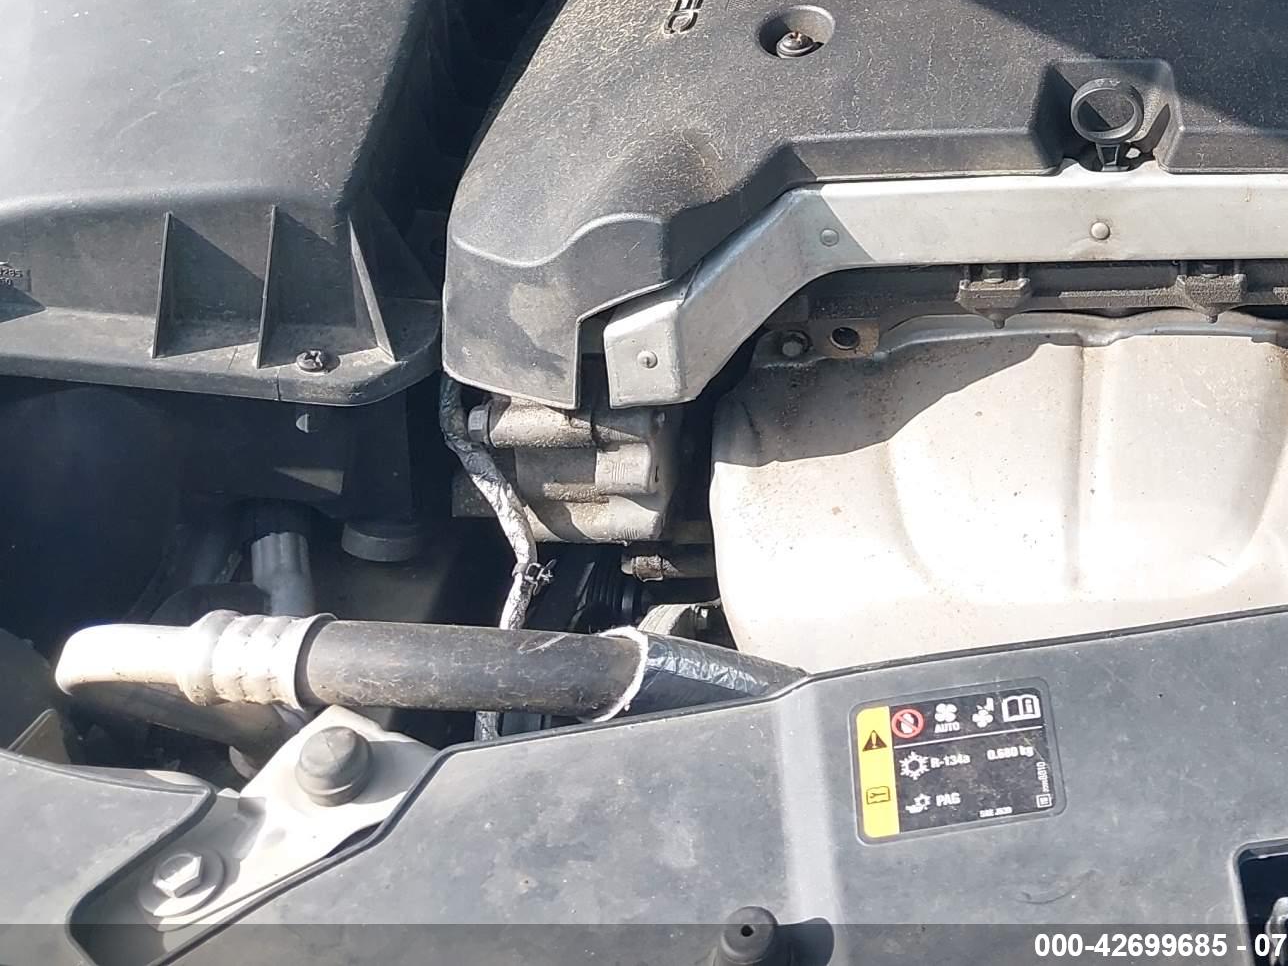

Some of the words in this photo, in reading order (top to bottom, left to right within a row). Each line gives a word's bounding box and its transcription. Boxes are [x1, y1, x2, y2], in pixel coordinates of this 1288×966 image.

[935, 722, 960, 733] AUTO
[931, 754, 971, 768] R-134a
[936, 792, 961, 806] PAG
